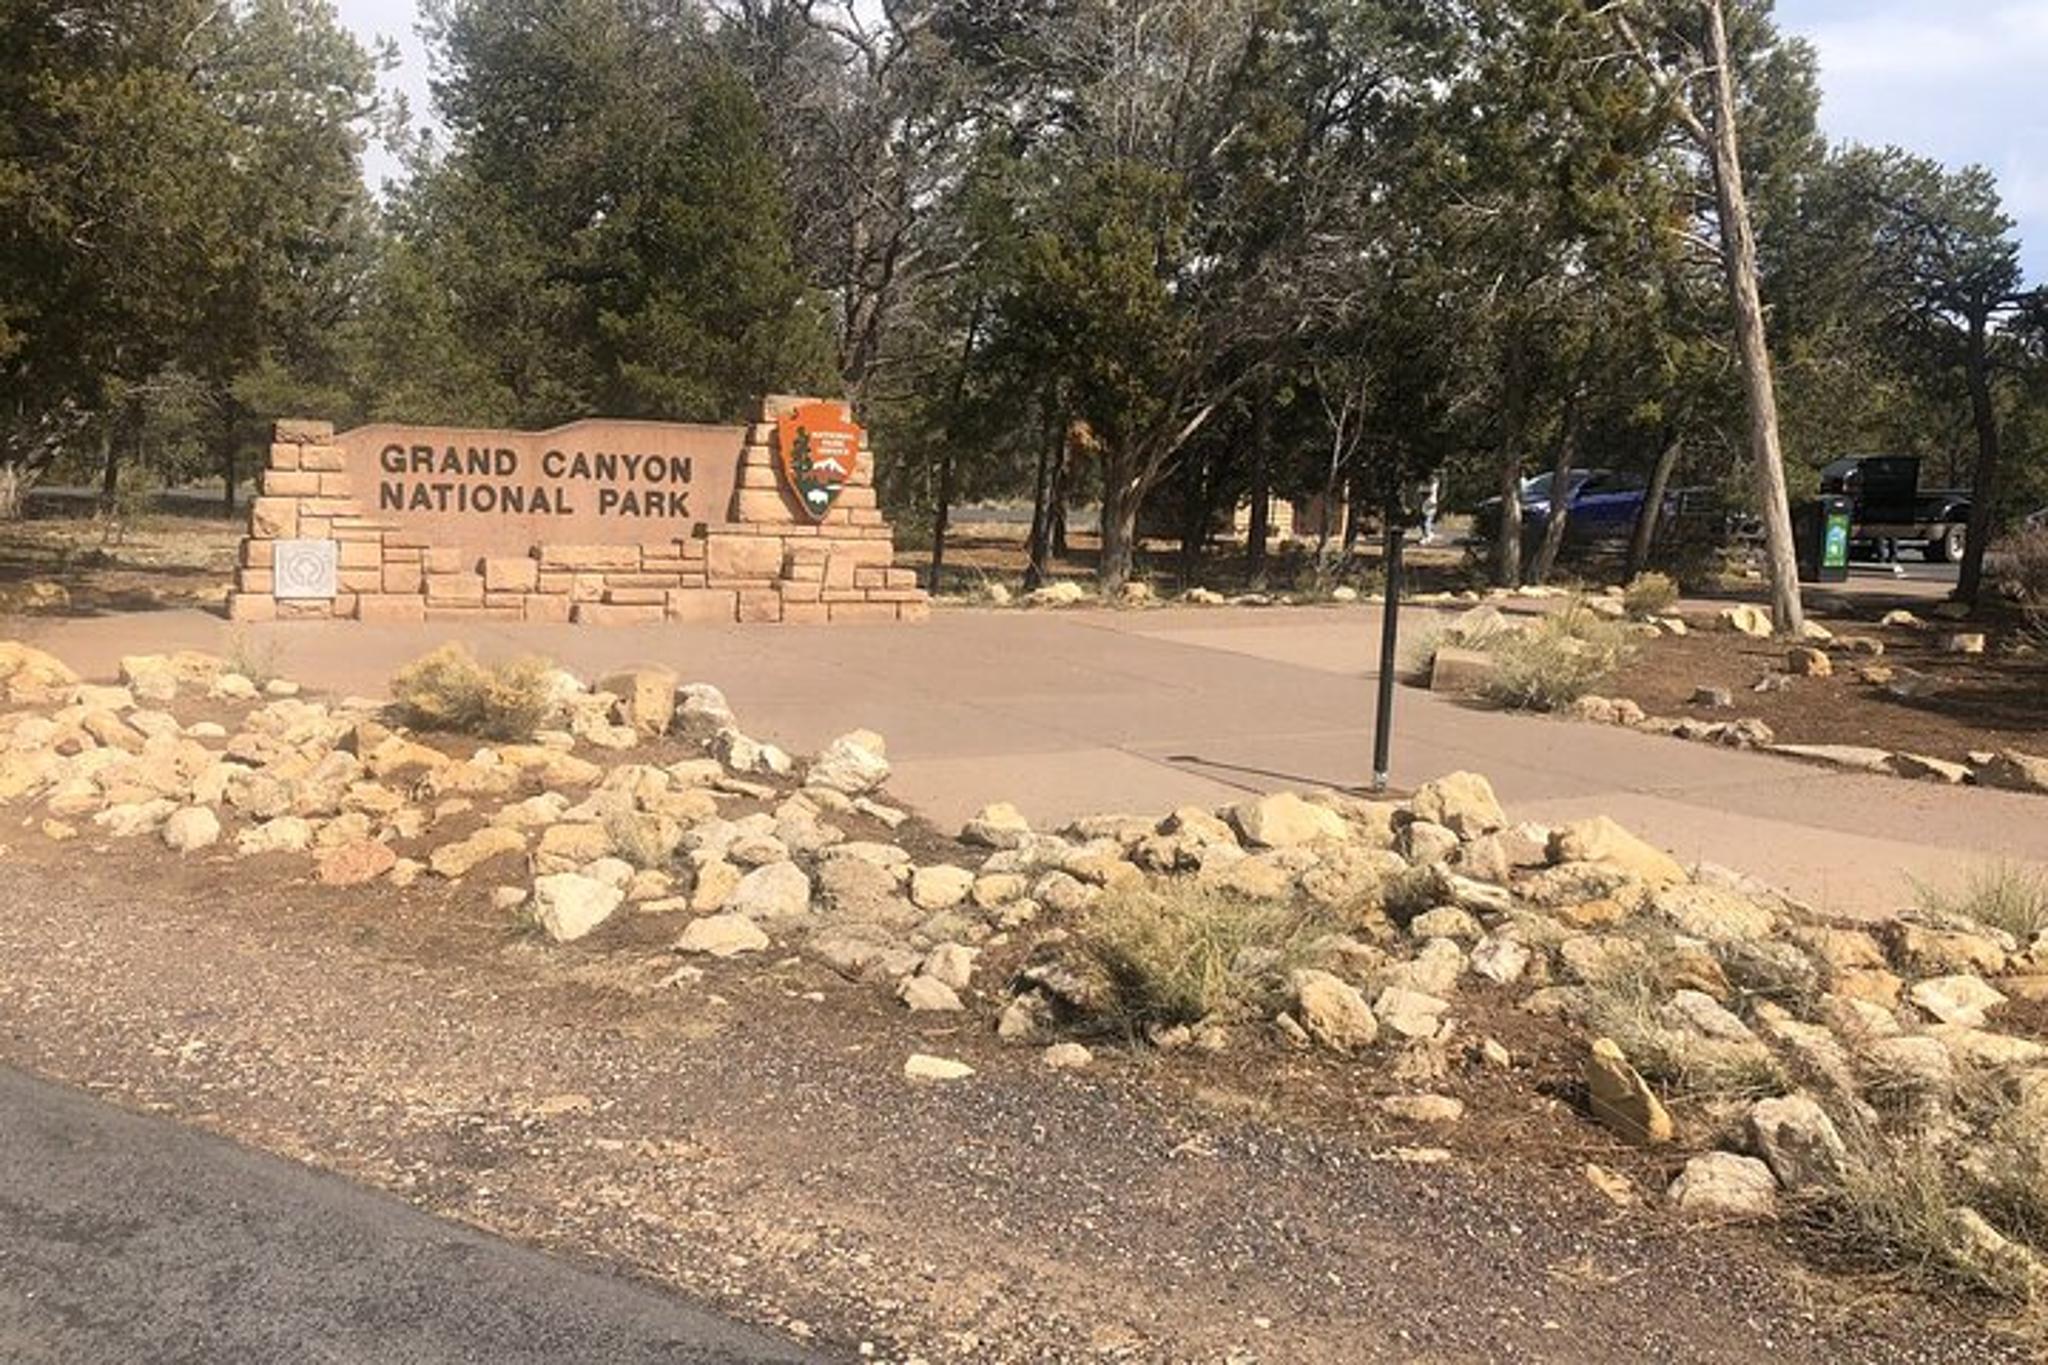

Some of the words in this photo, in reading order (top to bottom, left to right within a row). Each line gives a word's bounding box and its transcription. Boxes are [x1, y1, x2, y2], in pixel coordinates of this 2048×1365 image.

[380, 444, 517, 476] GRAND
[542, 450, 692, 483] CANYON
[380, 482, 573, 514] NATIONAL
[599, 489, 689, 517] PARK
